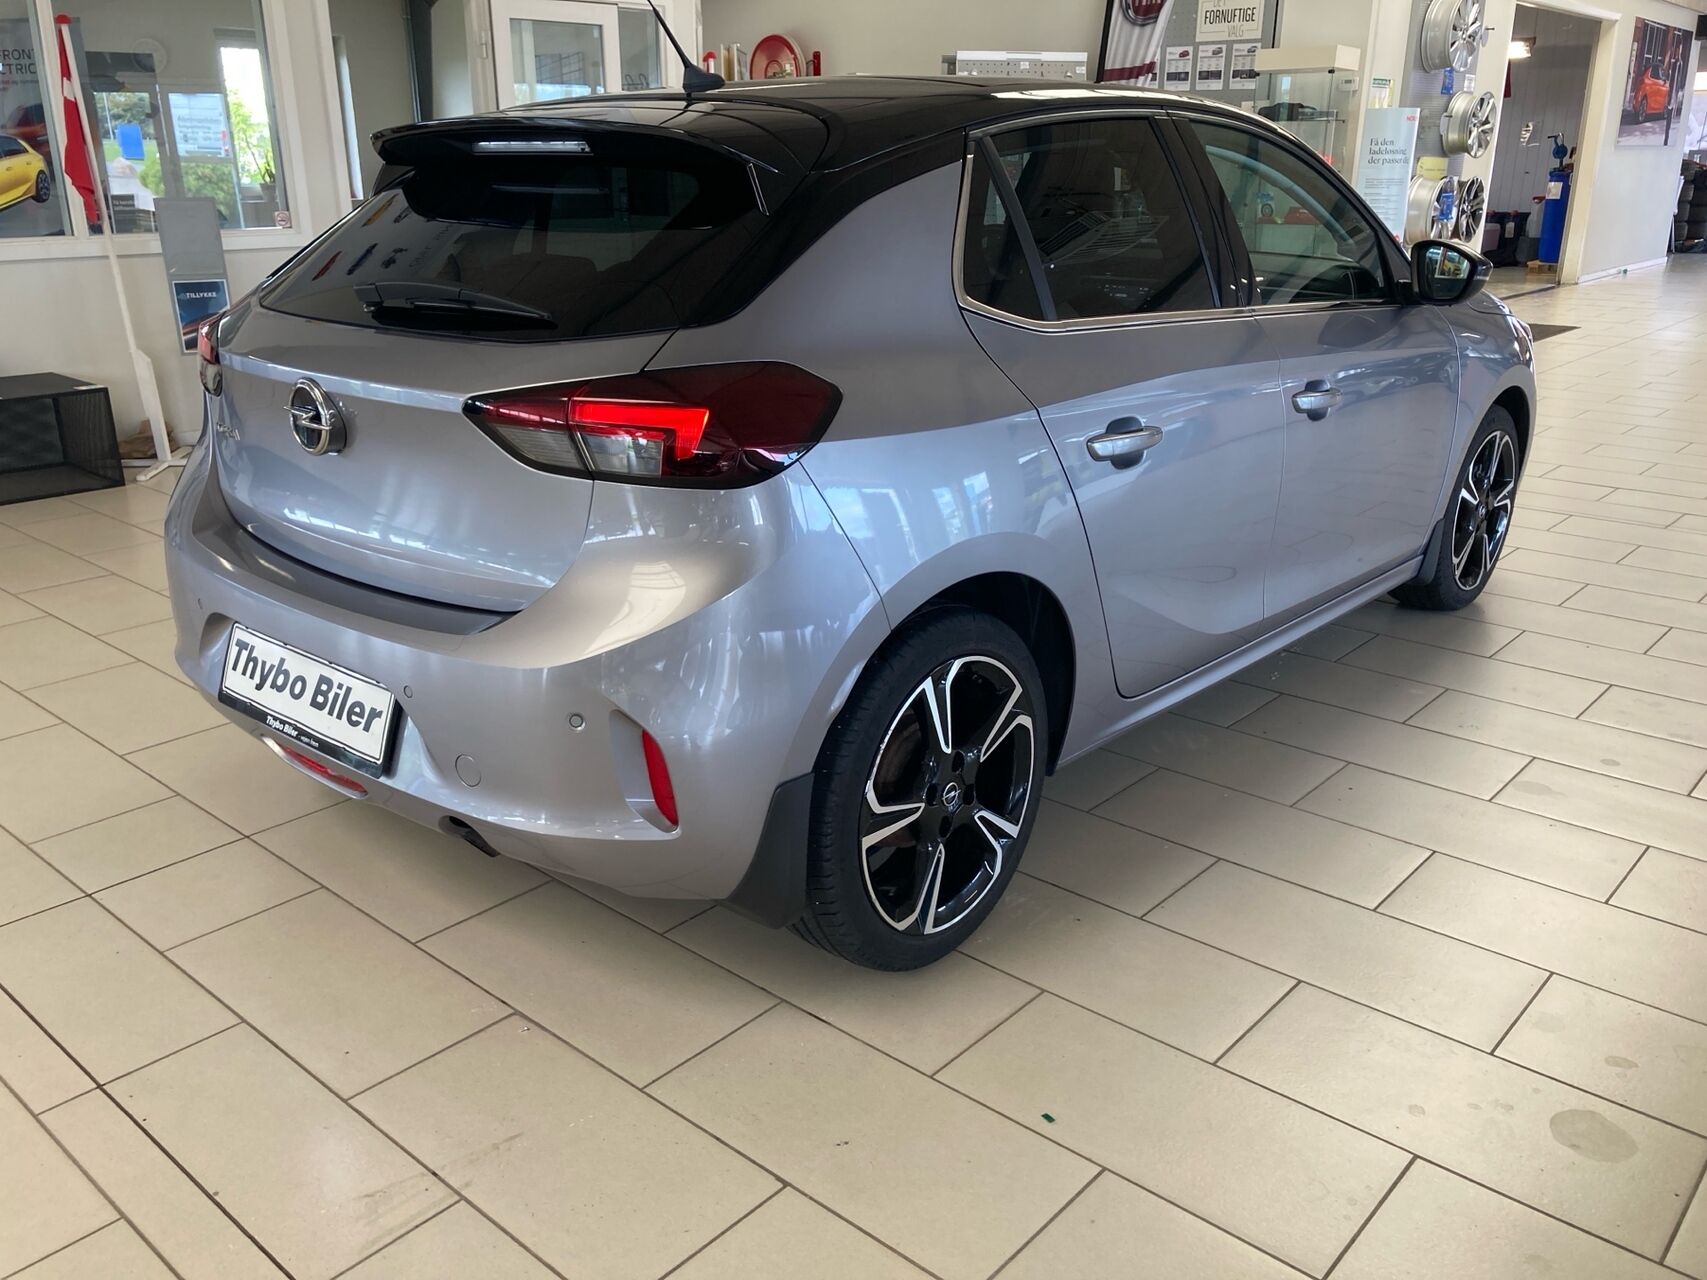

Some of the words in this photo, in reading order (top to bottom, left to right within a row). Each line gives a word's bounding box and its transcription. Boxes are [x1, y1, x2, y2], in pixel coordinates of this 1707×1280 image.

[1204, 7, 1256, 24] FORNUFTIGE
[1227, 24, 1244, 37] VALG
[0, 49, 34, 60] RON
[1370, 137, 1379, 146] Få
[1380, 138, 1394, 146] den
[1367, 156, 1380, 164] der
[1381, 157, 1402, 166] passer
[231, 638, 307, 701] Thybo
[309, 673, 383, 733] Biler
[266, 715, 283, 730] Thybo
[283, 723, 299, 737] Biler
